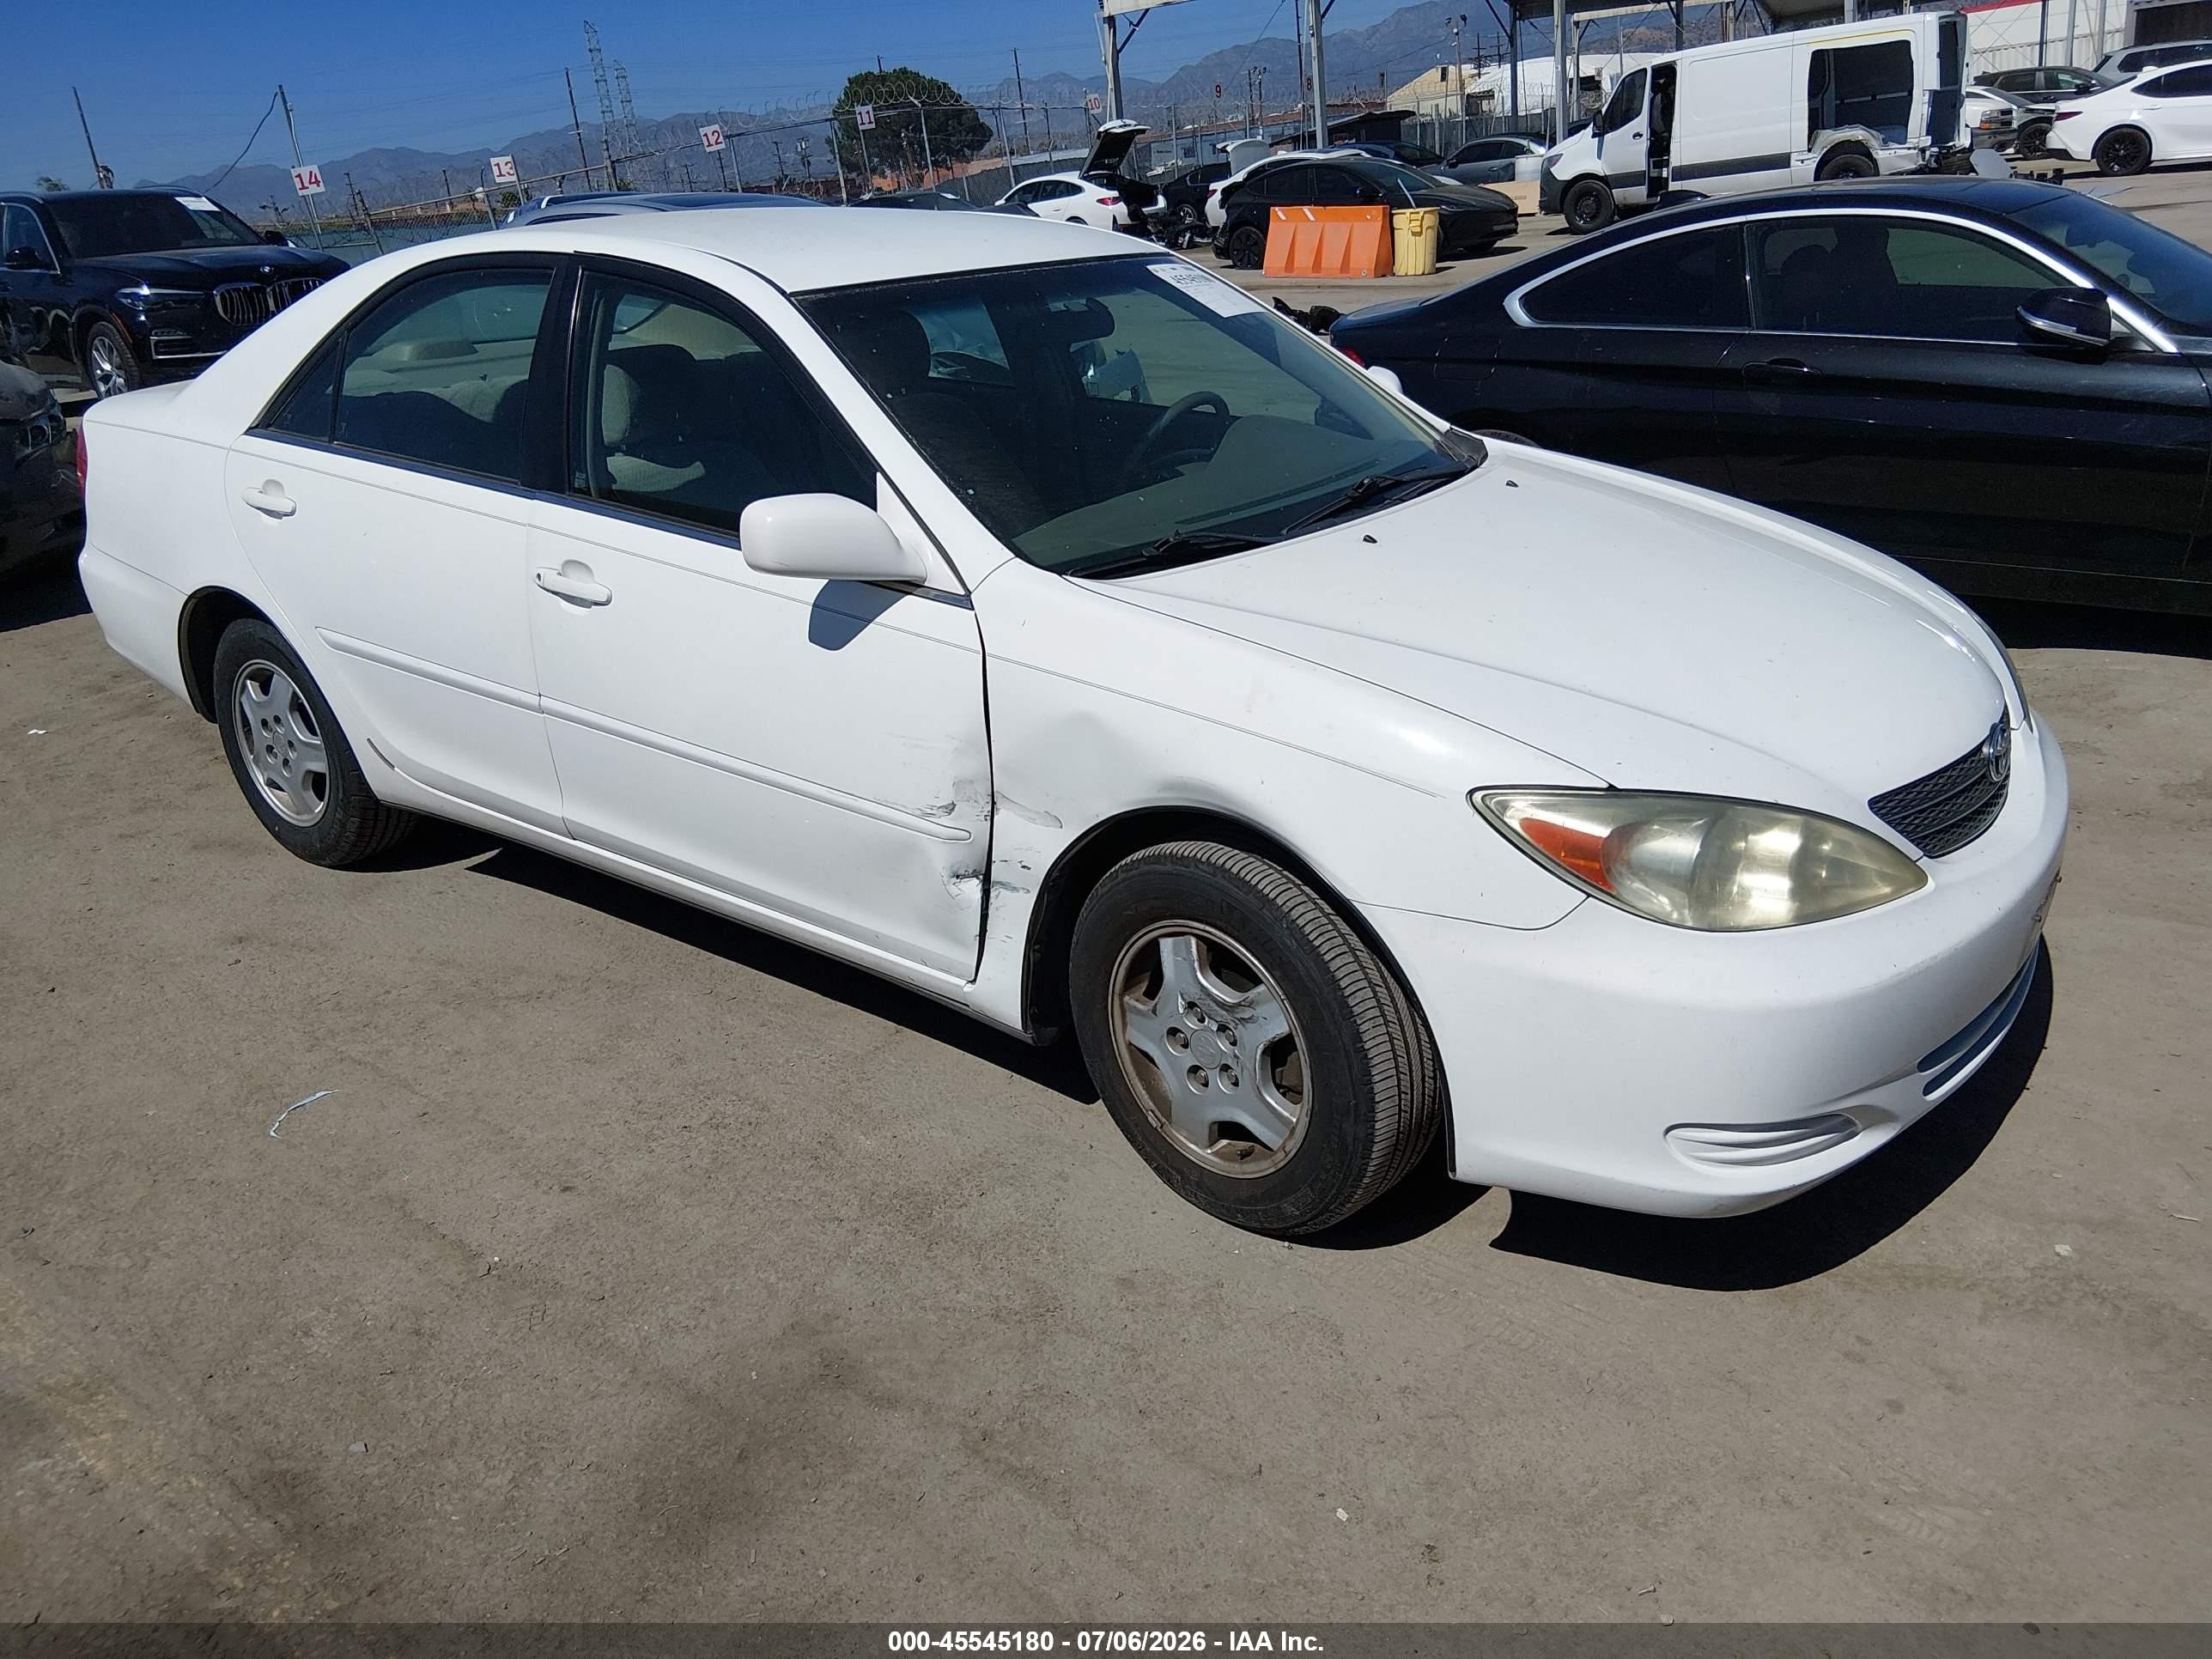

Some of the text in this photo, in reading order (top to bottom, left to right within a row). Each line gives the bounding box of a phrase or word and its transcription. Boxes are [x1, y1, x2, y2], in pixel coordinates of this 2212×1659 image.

[1215, 84, 1222, 98] 9
[1307, 77, 1312, 91] 8
[1088, 97, 1101, 111] 10
[857, 110, 874, 126] 11
[702, 130, 723, 148] 12
[494, 161, 515, 178] 13
[295, 170, 321, 191] 14
